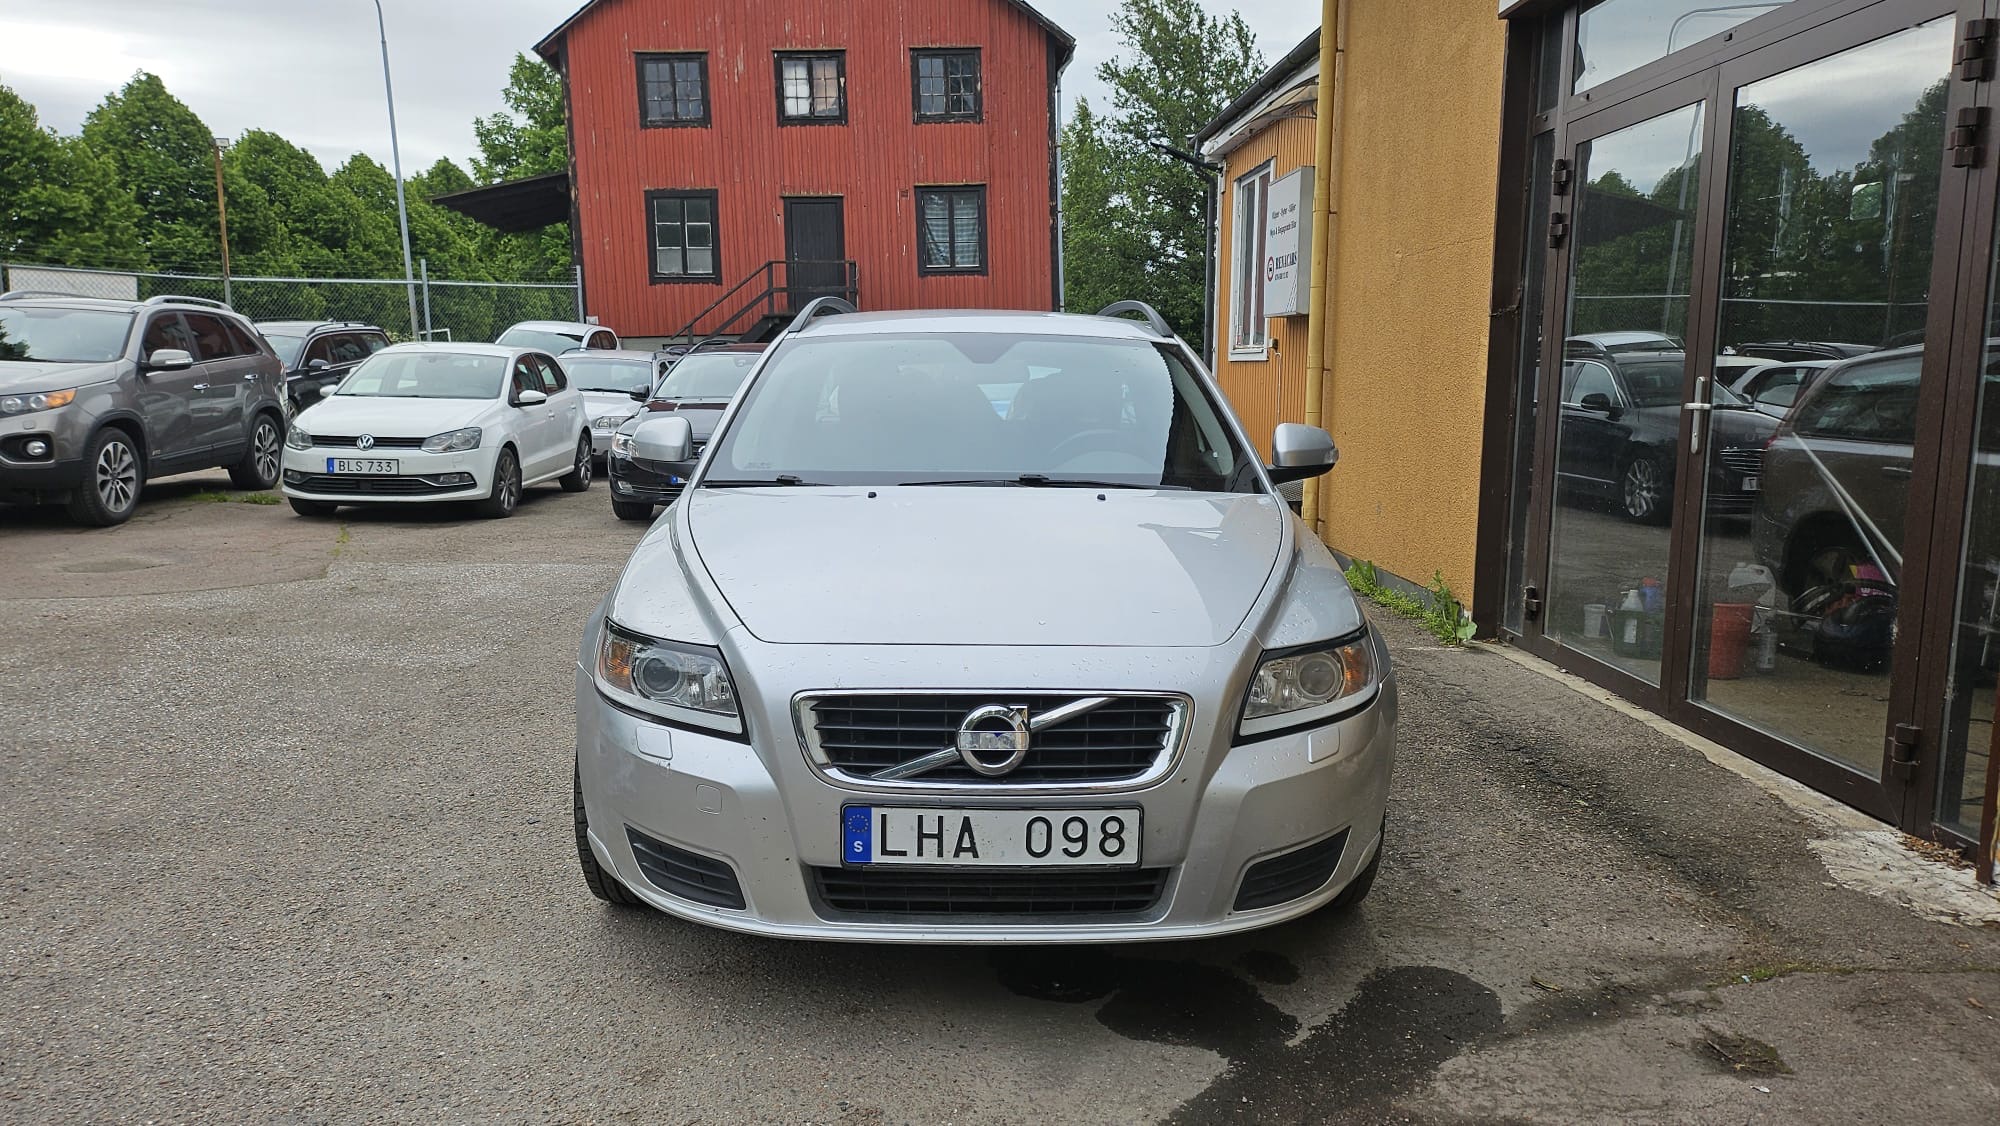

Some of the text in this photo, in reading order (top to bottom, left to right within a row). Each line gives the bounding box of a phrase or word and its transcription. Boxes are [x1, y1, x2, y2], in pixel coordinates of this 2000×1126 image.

[338, 460, 393, 473] BLS 733
[880, 813, 1126, 858] LHA 098
[853, 840, 864, 853] S
